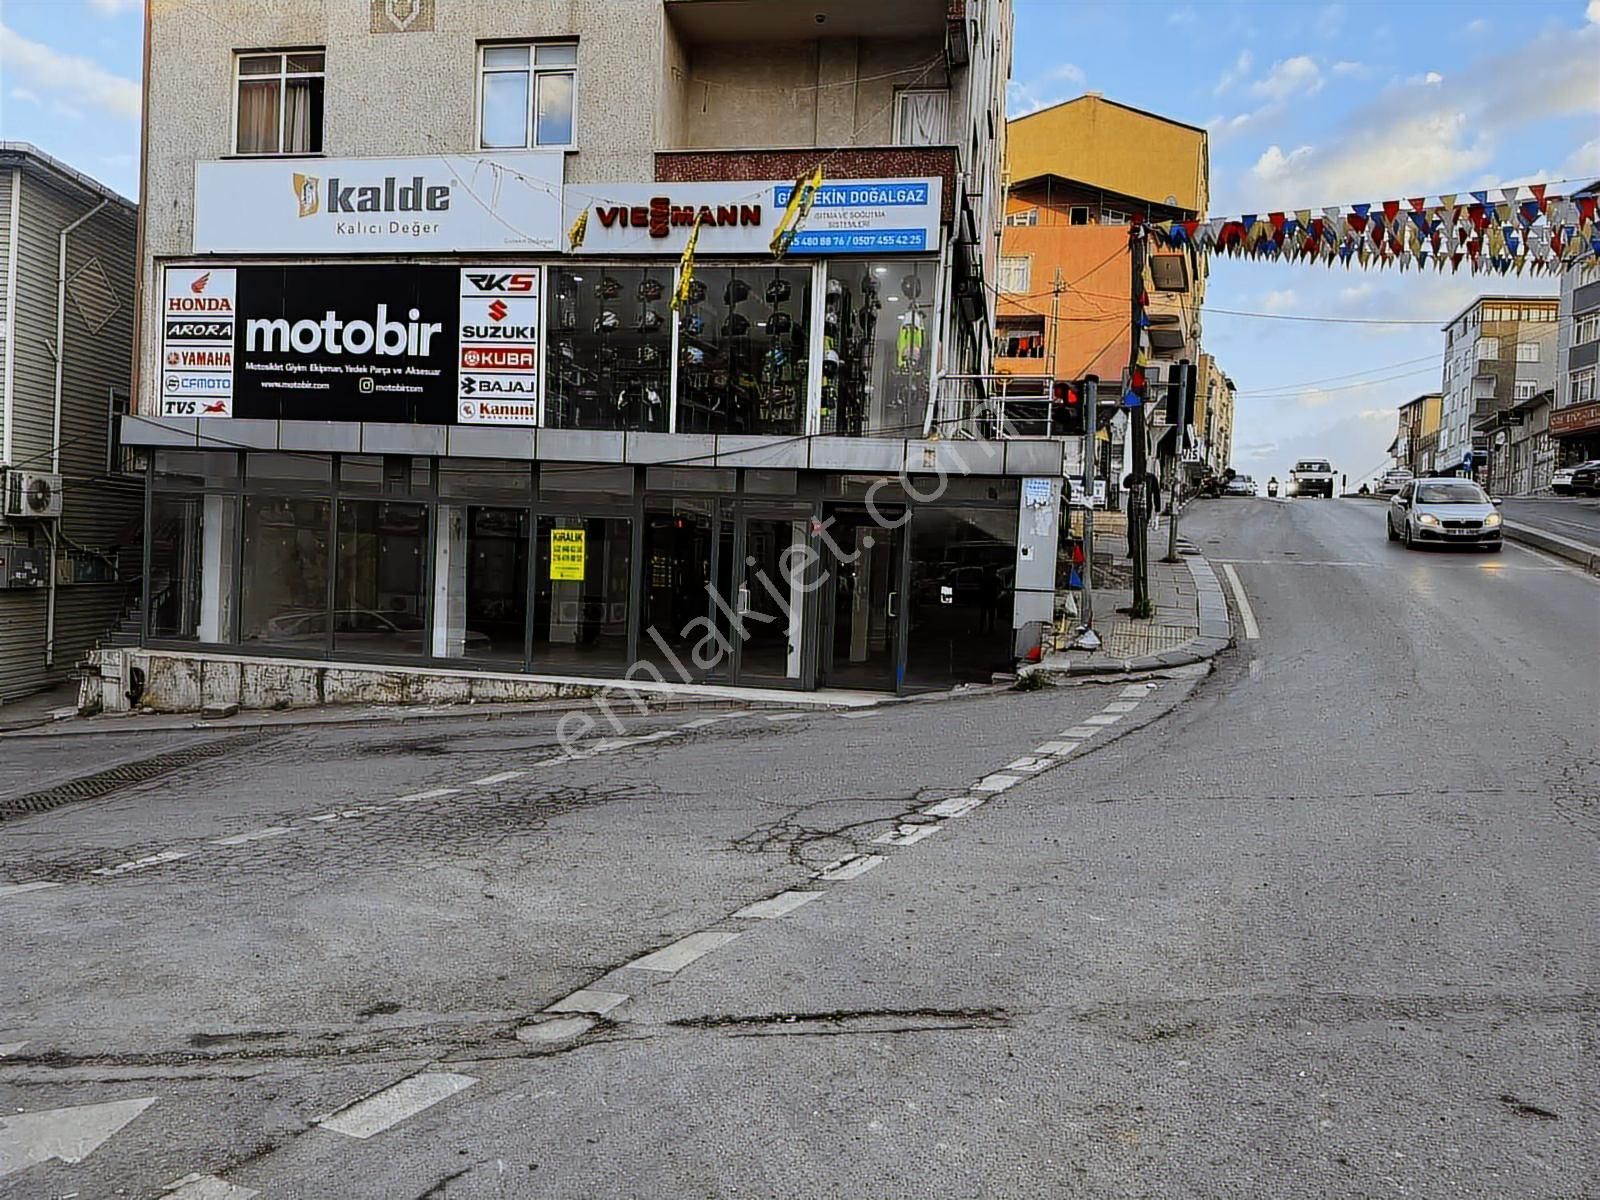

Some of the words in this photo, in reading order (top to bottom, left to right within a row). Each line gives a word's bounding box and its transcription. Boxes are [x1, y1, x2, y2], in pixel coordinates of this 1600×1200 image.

[327, 177, 450, 213] kalde
[850, 187, 924, 204] DOĞALGAZ
[336, 222, 383, 235] Kalıcı
[389, 221, 439, 236] Değer
[853, 236, 875, 246] 0507
[465, 274, 536, 292] RKS
[168, 298, 232, 311] HONDA
[168, 324, 232, 336] ARORA
[245, 303, 443, 357] motobir
[462, 326, 535, 339] SUZUKI
[181, 352, 231, 366] YAMAHA
[481, 352, 532, 366] KUBA
[181, 378, 231, 389] CFMOTO
[479, 381, 535, 393] BAJAJ
[165, 401, 196, 415] TVS
[480, 403, 534, 415] Kanuni
